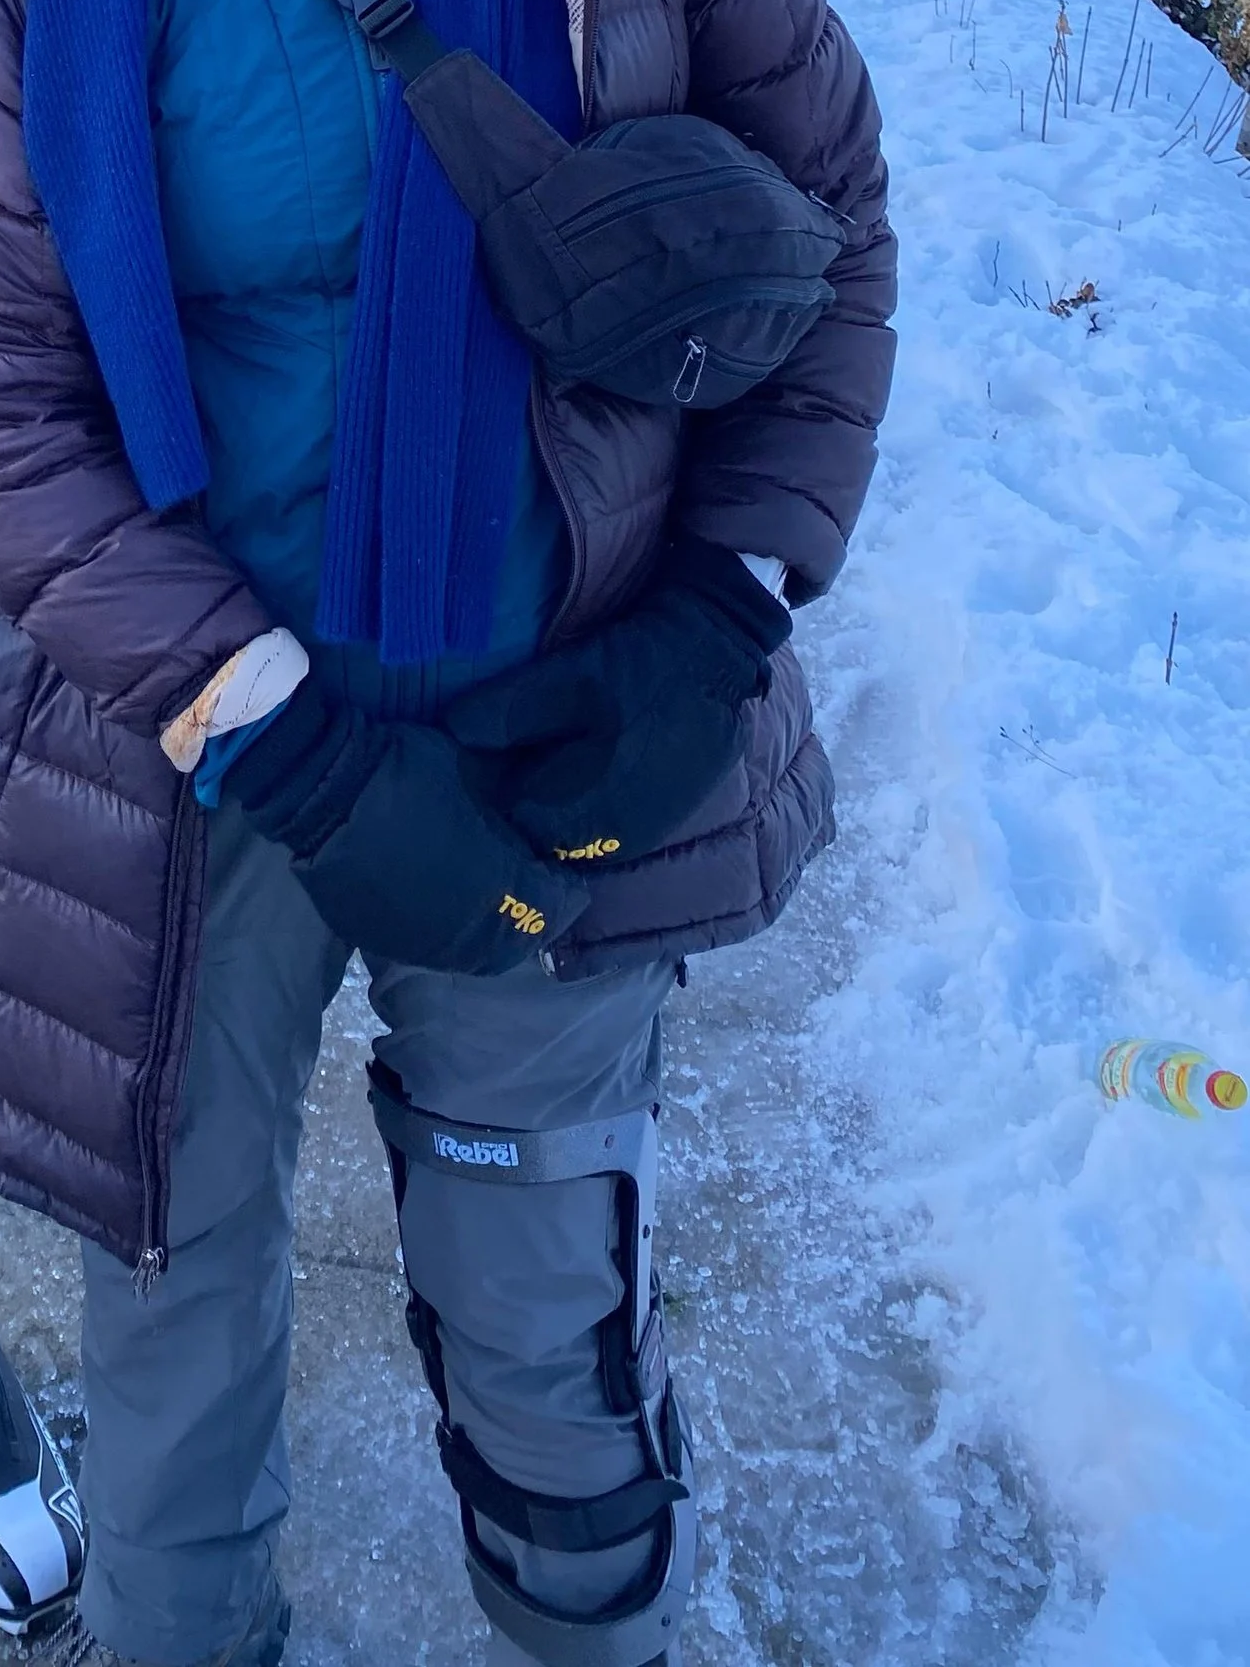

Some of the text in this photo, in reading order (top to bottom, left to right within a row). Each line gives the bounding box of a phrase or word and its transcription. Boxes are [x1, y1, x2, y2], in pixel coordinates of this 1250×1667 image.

[553, 838, 620, 861] TOKO
[498, 894, 545, 934] TOKO
[433, 1132, 519, 1167] Rebel
